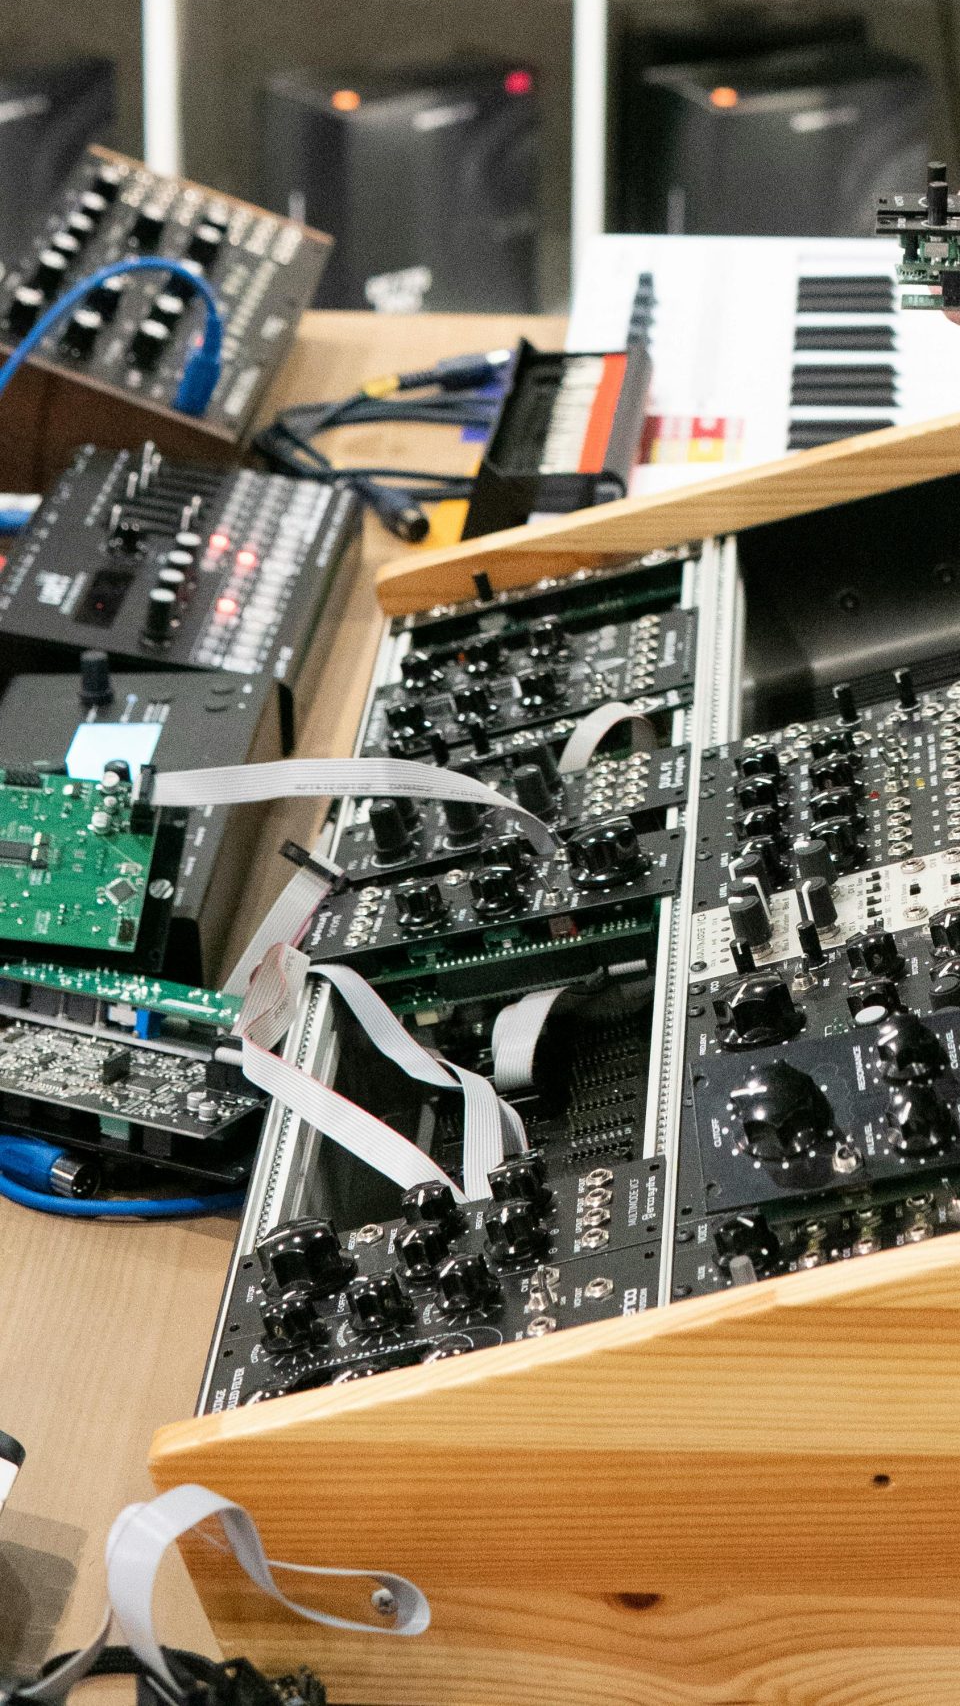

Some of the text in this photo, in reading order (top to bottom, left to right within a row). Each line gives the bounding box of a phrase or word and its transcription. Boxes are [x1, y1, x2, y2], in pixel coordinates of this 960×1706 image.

[710, 980, 718, 993] VCO
[945, 1029, 956, 1054] LEVEL
[852, 1044, 865, 1091] RESONANCE
[711, 1116, 721, 1148] CUTOFF
[628, 1177, 638, 1226] MULTIMODE VCF
[230, 1366, 244, 1390] FILTER
